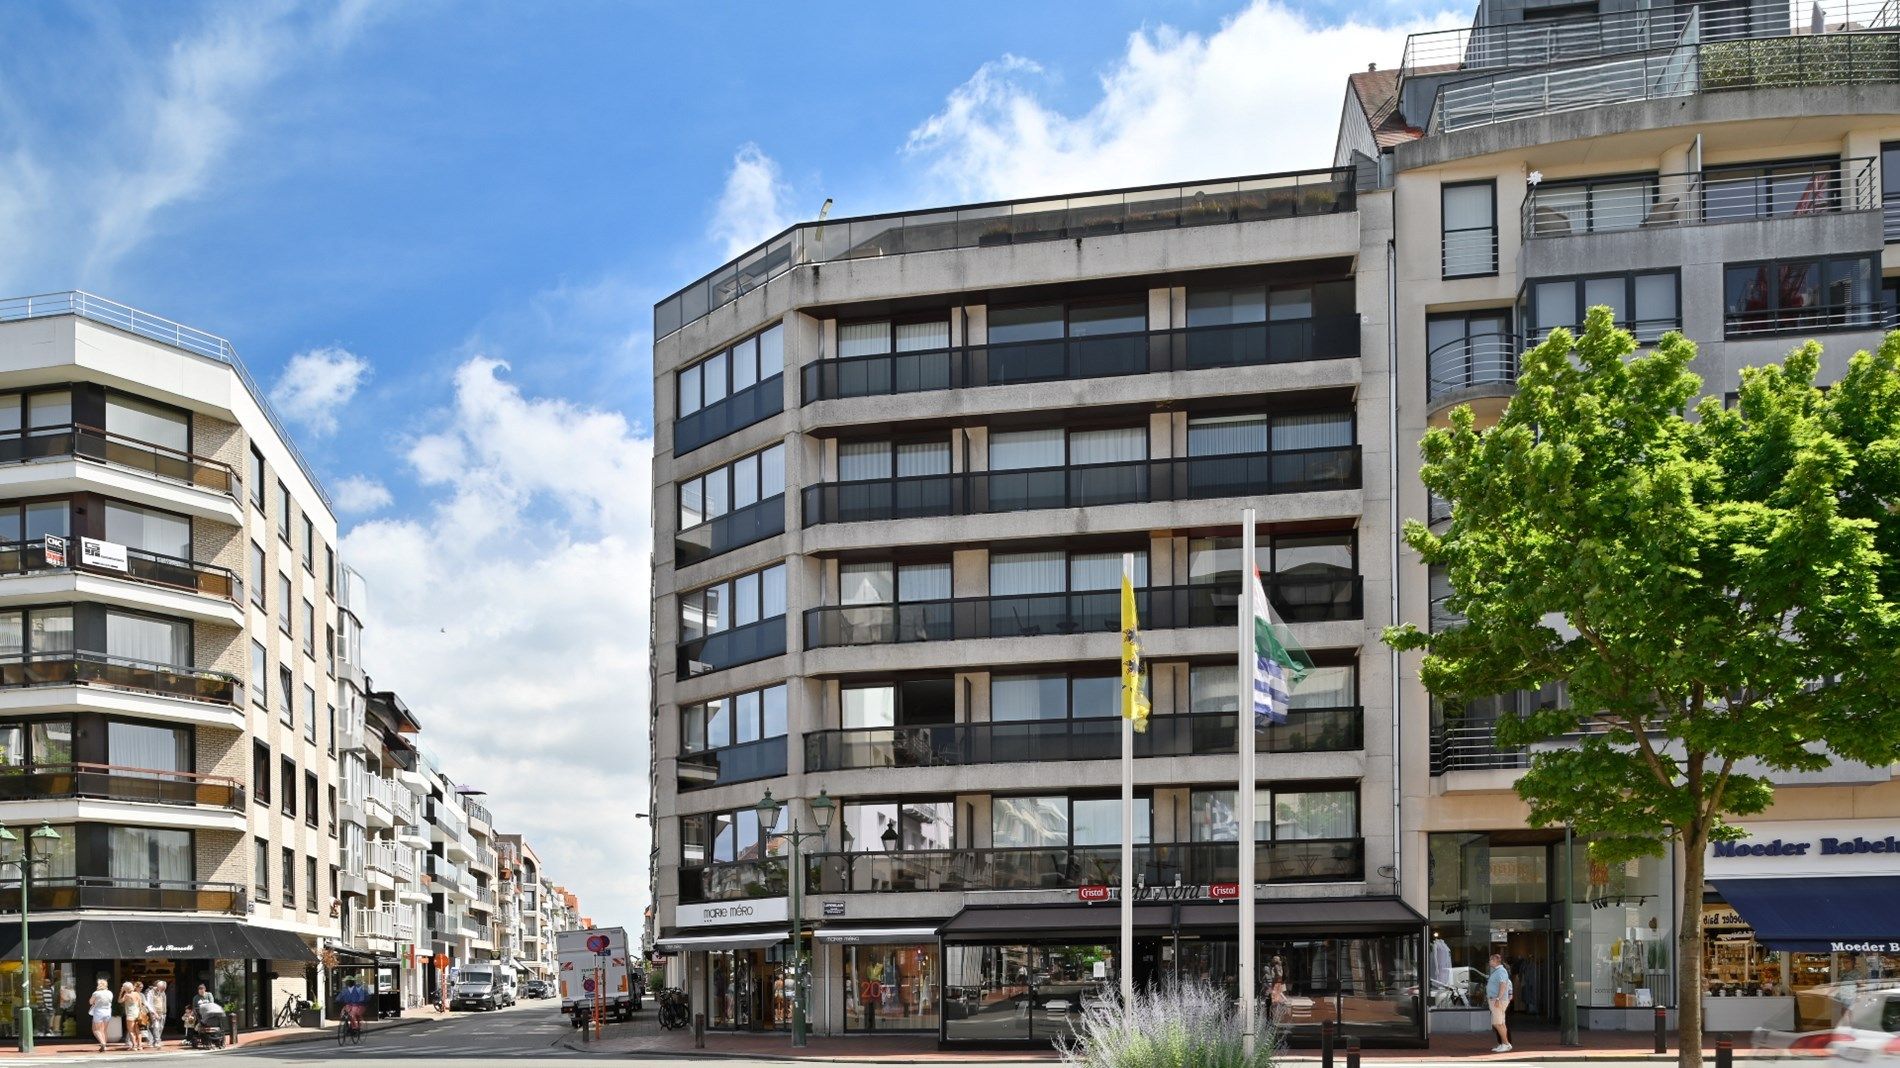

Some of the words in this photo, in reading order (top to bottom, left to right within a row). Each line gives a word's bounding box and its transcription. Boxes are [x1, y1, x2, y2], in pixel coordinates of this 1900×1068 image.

[1713, 839, 1810, 858] Moeder
[1081, 887, 1104, 899] Cristal
[1212, 885, 1236, 897] Cristal
[1831, 942, 1885, 952] Moeder
